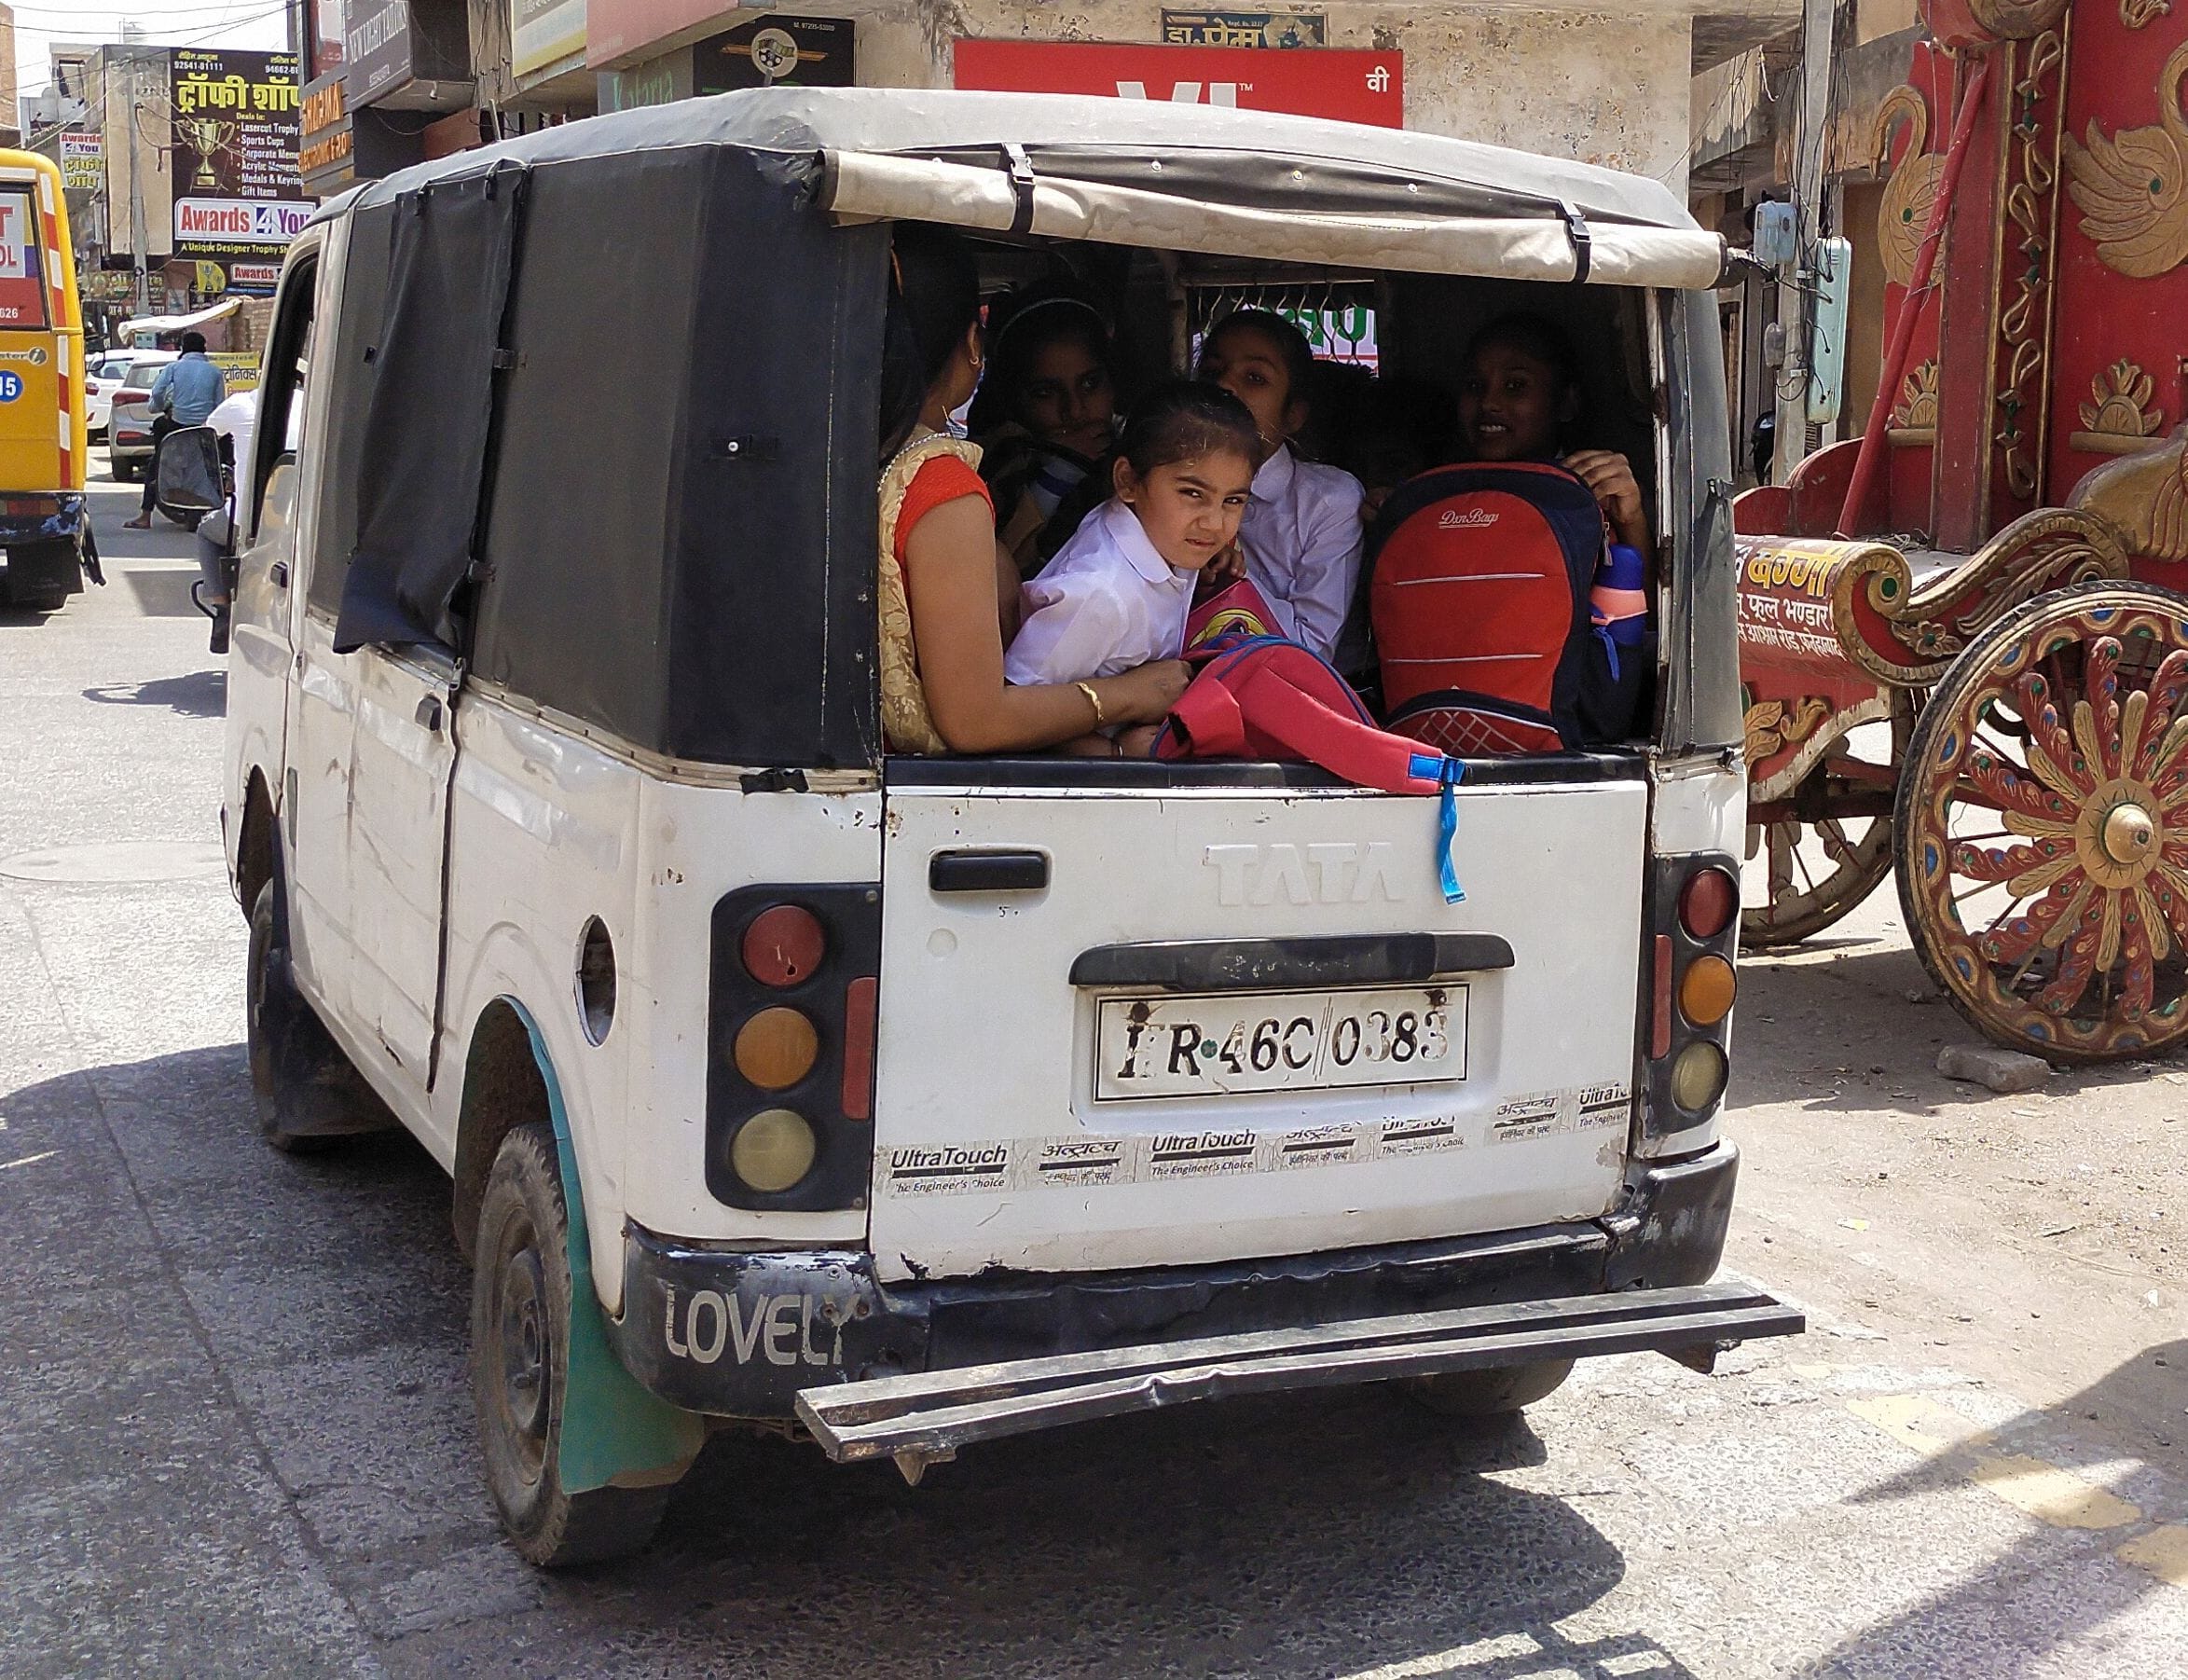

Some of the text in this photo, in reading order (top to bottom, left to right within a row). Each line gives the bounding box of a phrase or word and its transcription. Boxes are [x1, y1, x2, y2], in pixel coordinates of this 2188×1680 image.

[1366, 65, 1390, 92] वी
[177, 73, 250, 113] ट्रॉफी
[241, 122, 299, 135] Lasercut Trophy
[62, 133, 104, 144] Awards
[241, 134, 284, 147] Sports Cups
[78, 144, 100, 153] You
[241, 147, 278, 159] Corporate
[241, 173, 268, 185] Medals
[242, 186, 278, 197] Gift Items
[181, 204, 250, 233] Awards
[181, 241, 290, 255] A Unique Designer Trophy Sh
[234, 267, 275, 281] Awards
[1746, 593, 1780, 623] फूल
[1782, 598, 1830, 632] भण्डार
[1204, 842, 1406, 907] TATA
[891, 1145, 1008, 1168] UltraTouch
[1151, 1160, 1254, 1177] The Engineer's Choice
[896, 1179, 911, 1193] he
[913, 1177, 968, 1193] Engineer's
[665, 1286, 863, 1366] LOVELY
